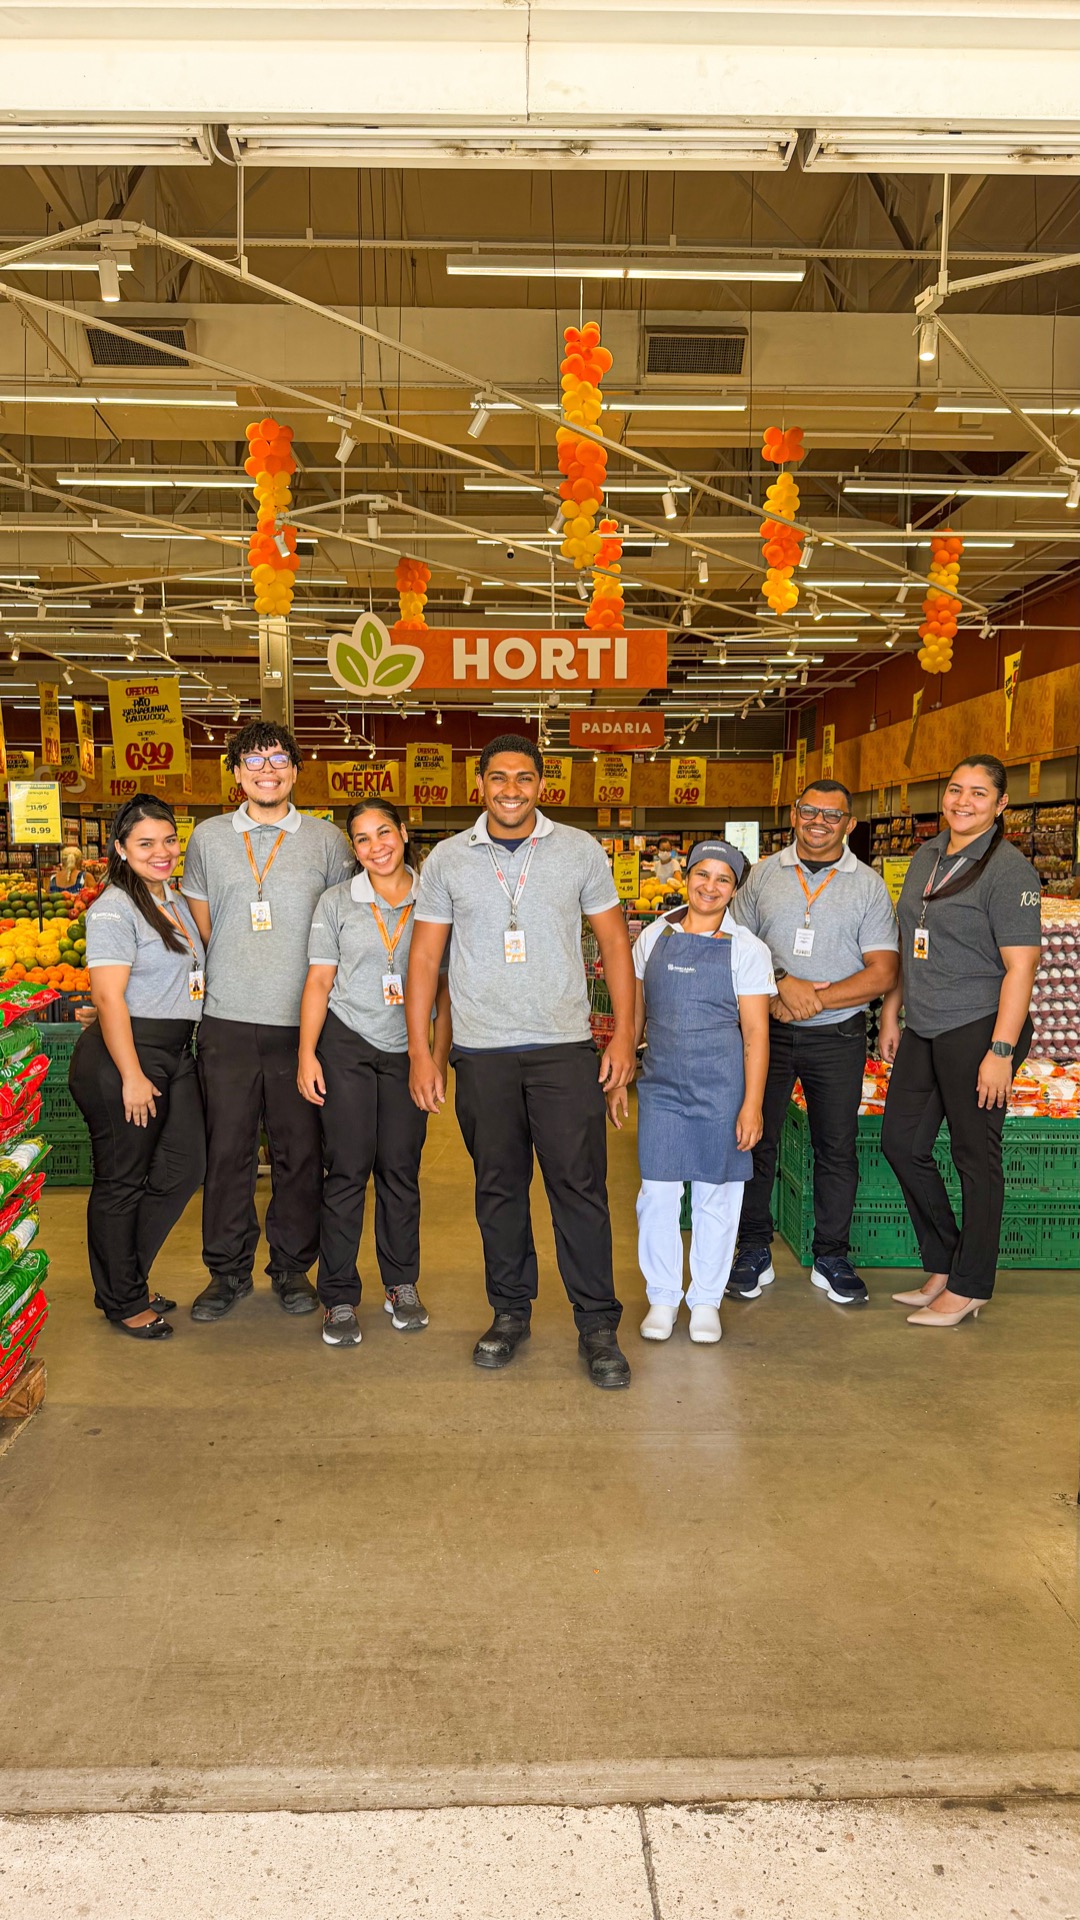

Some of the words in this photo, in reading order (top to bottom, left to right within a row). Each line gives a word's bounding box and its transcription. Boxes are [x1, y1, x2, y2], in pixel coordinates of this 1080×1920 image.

[453, 637, 628, 681] HORTI
[125, 686, 159, 697] OFERTA
[582, 722, 652, 734] PADARIA
[417, 747, 439, 755] OFERTA
[352, 763, 368, 772] AQUI
[372, 763, 386, 771] TEM
[331, 771, 394, 793] OFERTA
[346, 790, 365, 798] TODO
[31, 827, 51, 835] 8,99
